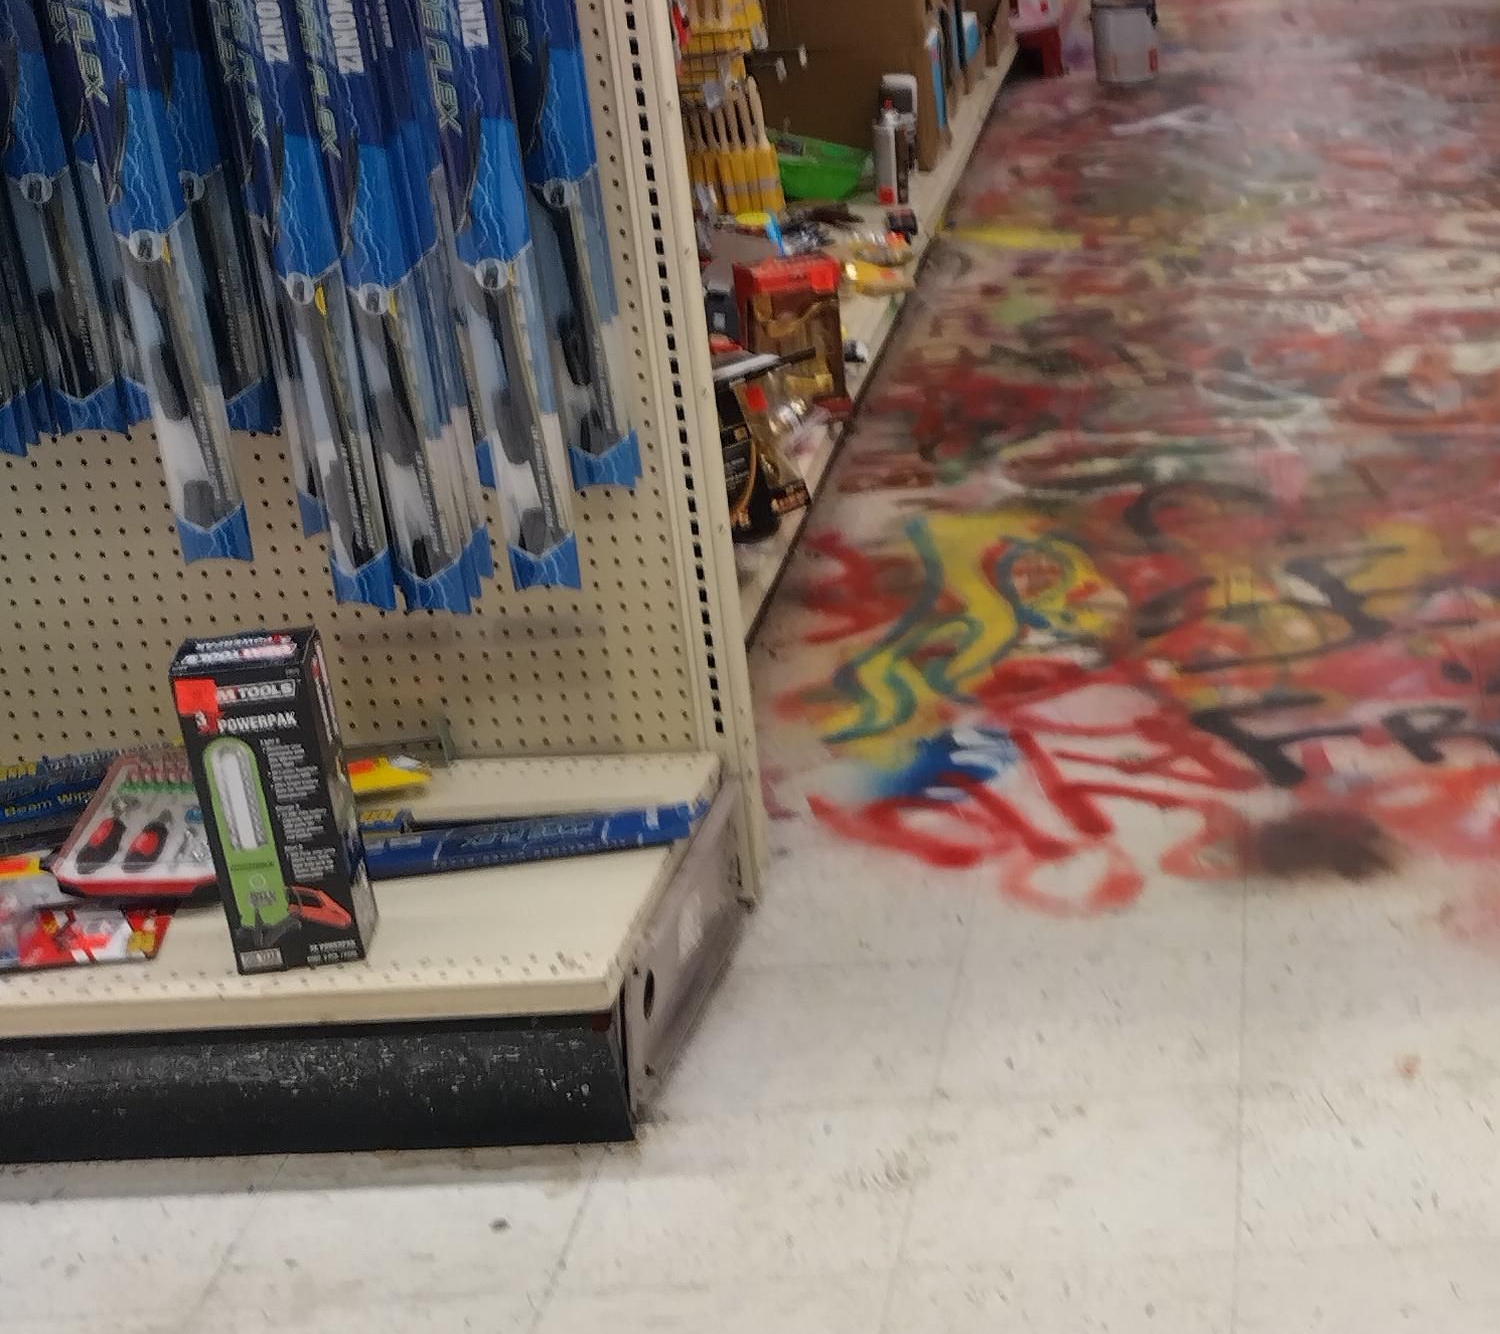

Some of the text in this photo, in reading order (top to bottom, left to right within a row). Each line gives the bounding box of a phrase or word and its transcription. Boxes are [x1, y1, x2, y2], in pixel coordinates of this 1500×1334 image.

[67, 8, 109, 108] FLEX
[425, 36, 463, 137] FLEX
[238, 682, 293, 699] TOOLS
[217, 711, 298, 734] POWERPAK
